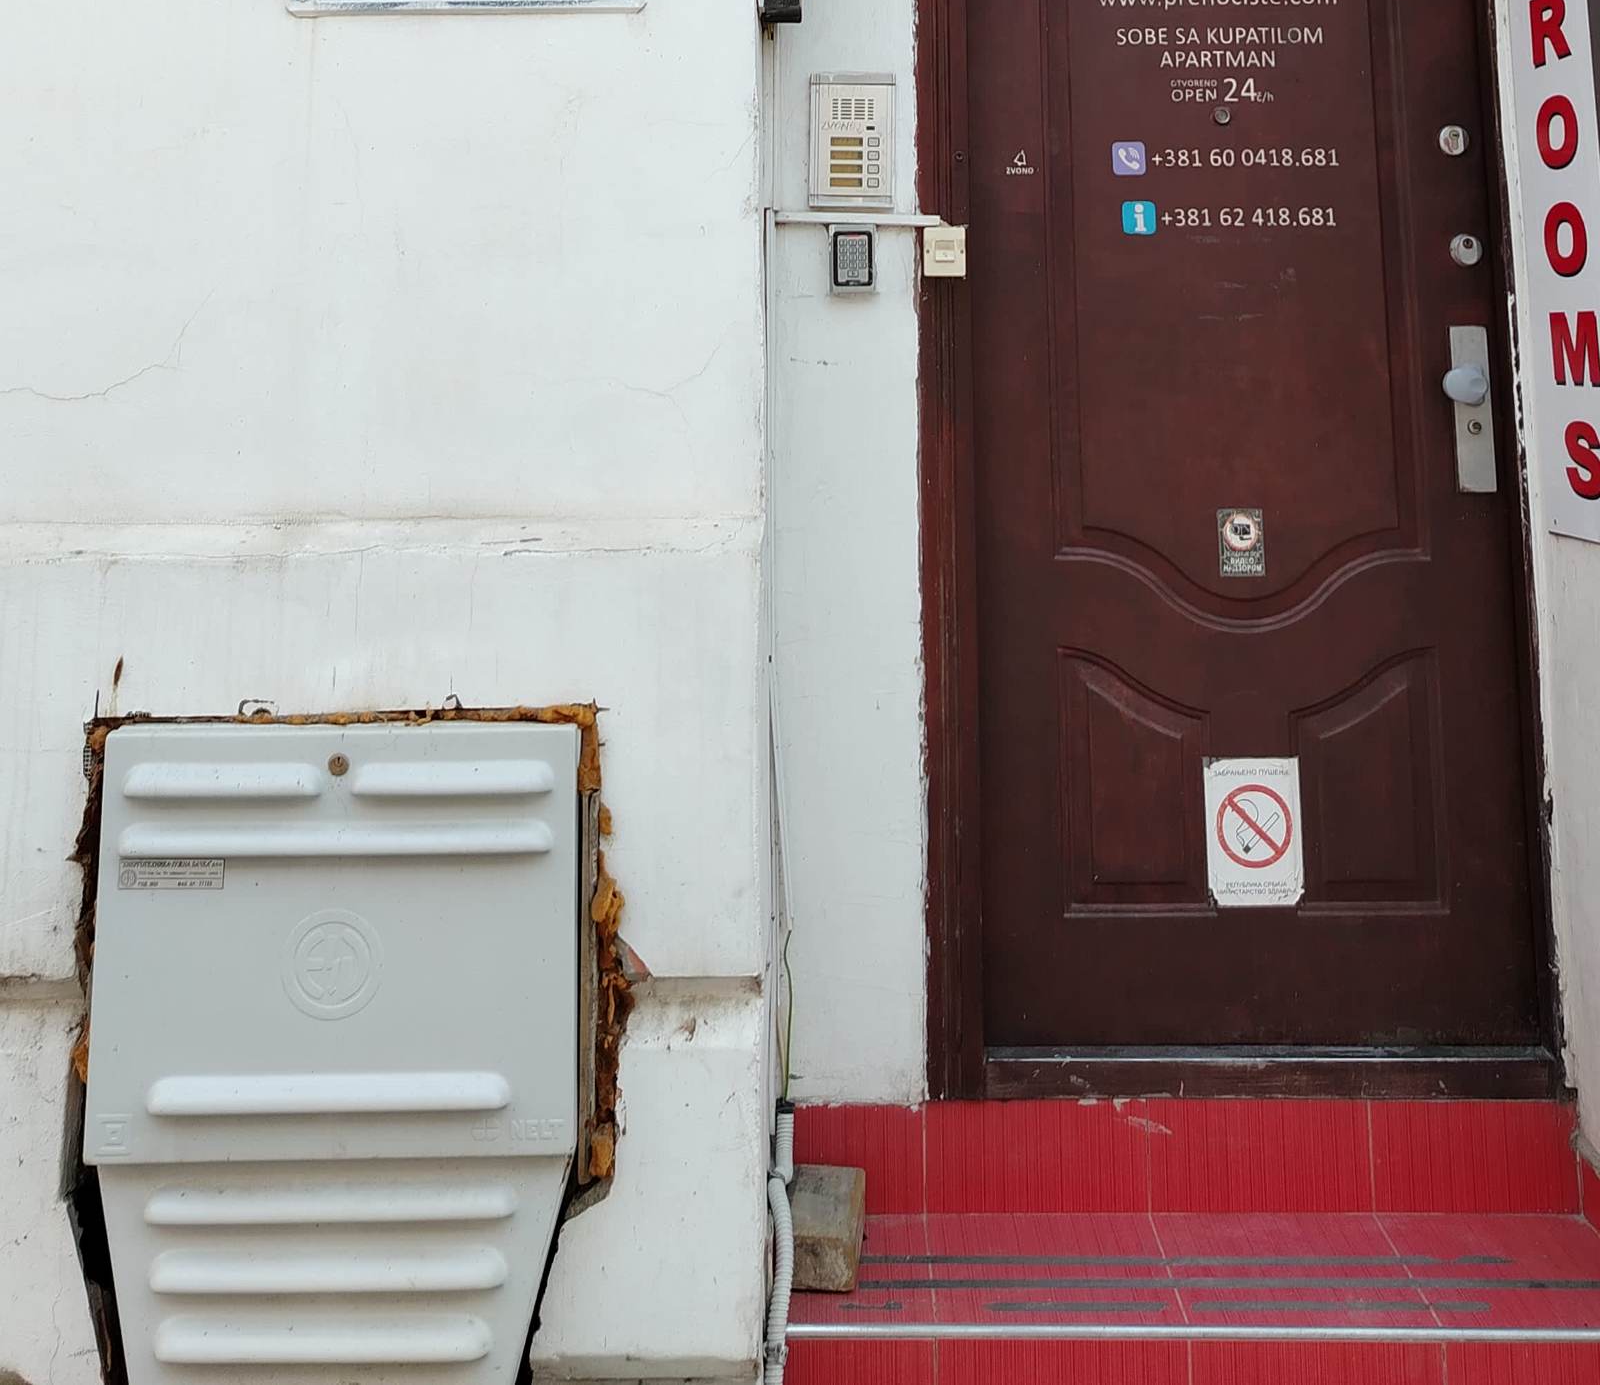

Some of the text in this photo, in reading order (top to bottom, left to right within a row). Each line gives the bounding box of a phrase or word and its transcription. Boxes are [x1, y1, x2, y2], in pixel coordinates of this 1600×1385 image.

[1116, 26, 1324, 45] SOBE SA KUPATILOM
[1160, 50, 1276, 68] APARTMAN
[1170, 79, 1218, 88] OTVORENO
[1171, 89, 1217, 102] OPEN
[1151, 148, 1340, 167] +381 60 0418.681
[1006, 166, 1034, 175] ZVONO
[1161, 207, 1337, 226] +381 62 418.681
